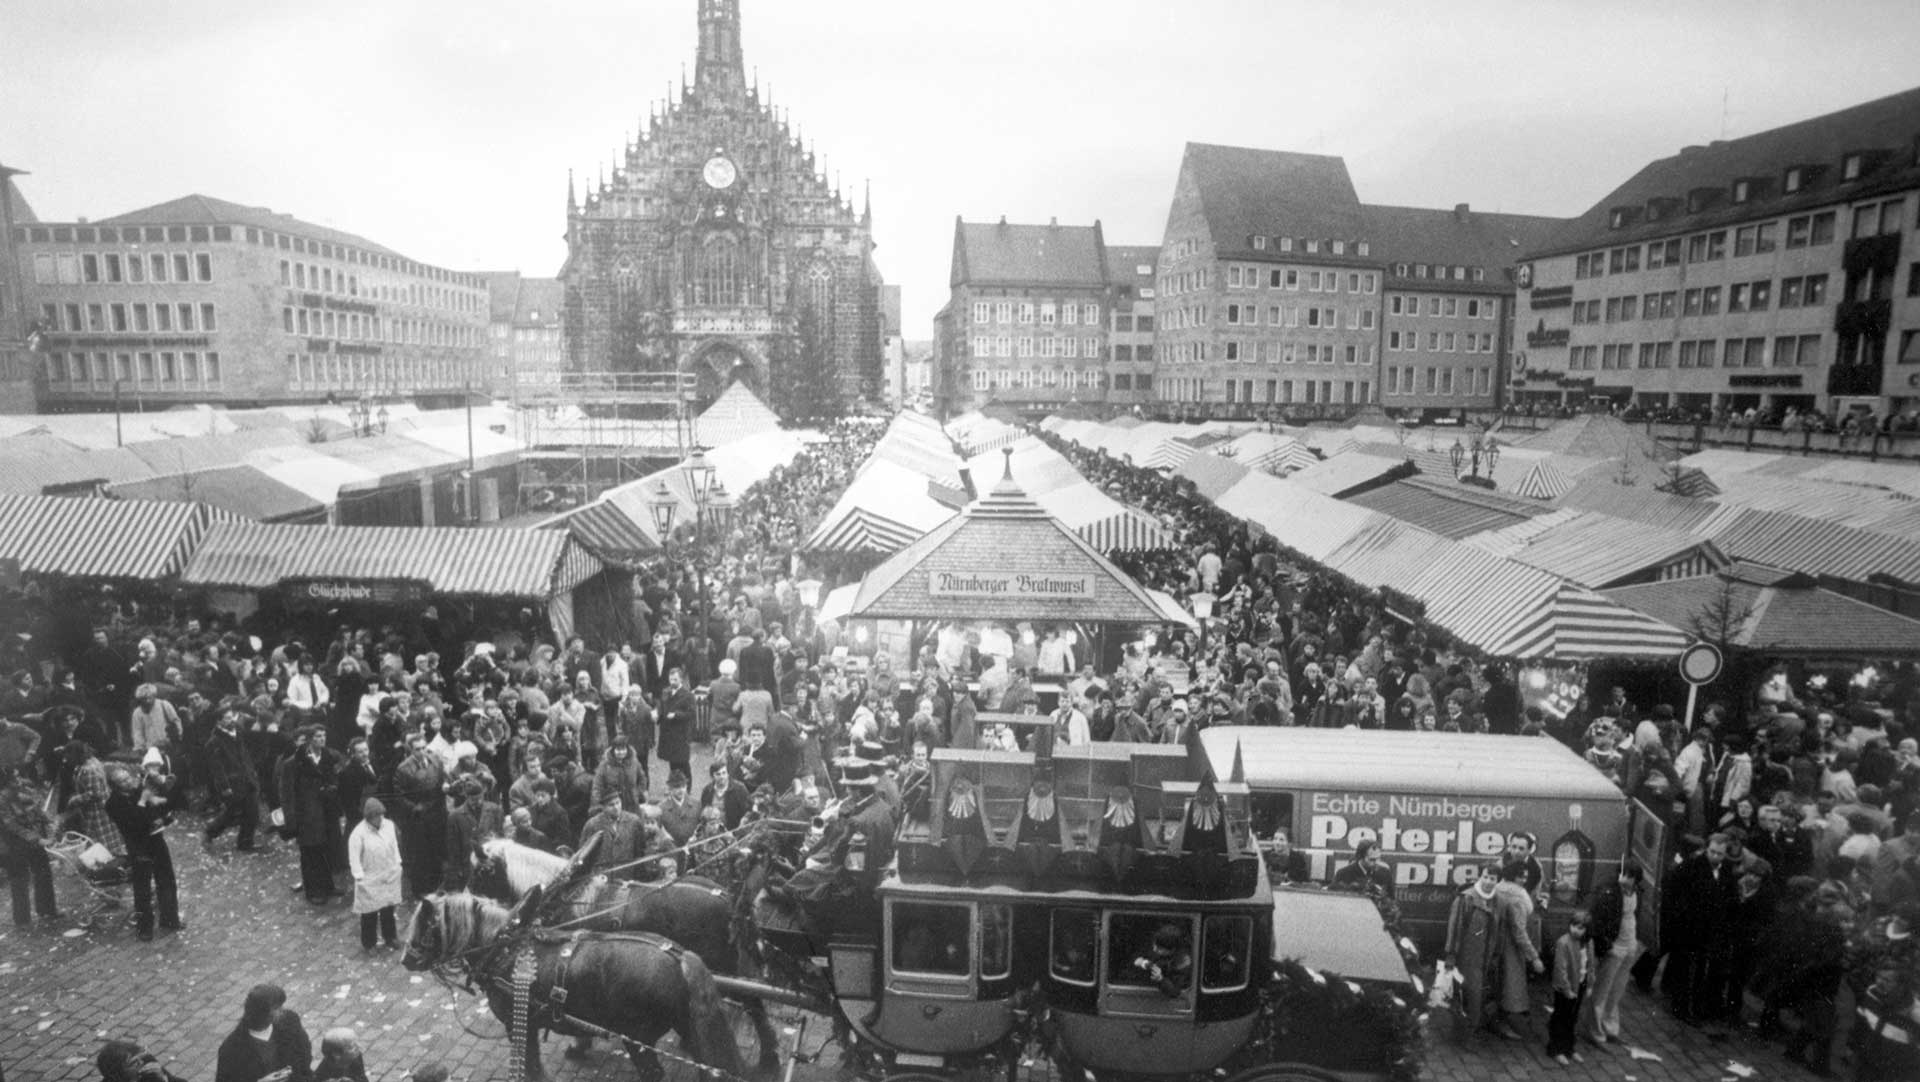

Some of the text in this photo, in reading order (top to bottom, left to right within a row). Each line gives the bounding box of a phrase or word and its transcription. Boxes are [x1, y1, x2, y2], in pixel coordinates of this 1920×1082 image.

[938, 573, 1085, 594] Nürnberger Bratwurst
[1312, 793, 1515, 822] Echte Nürnberger
